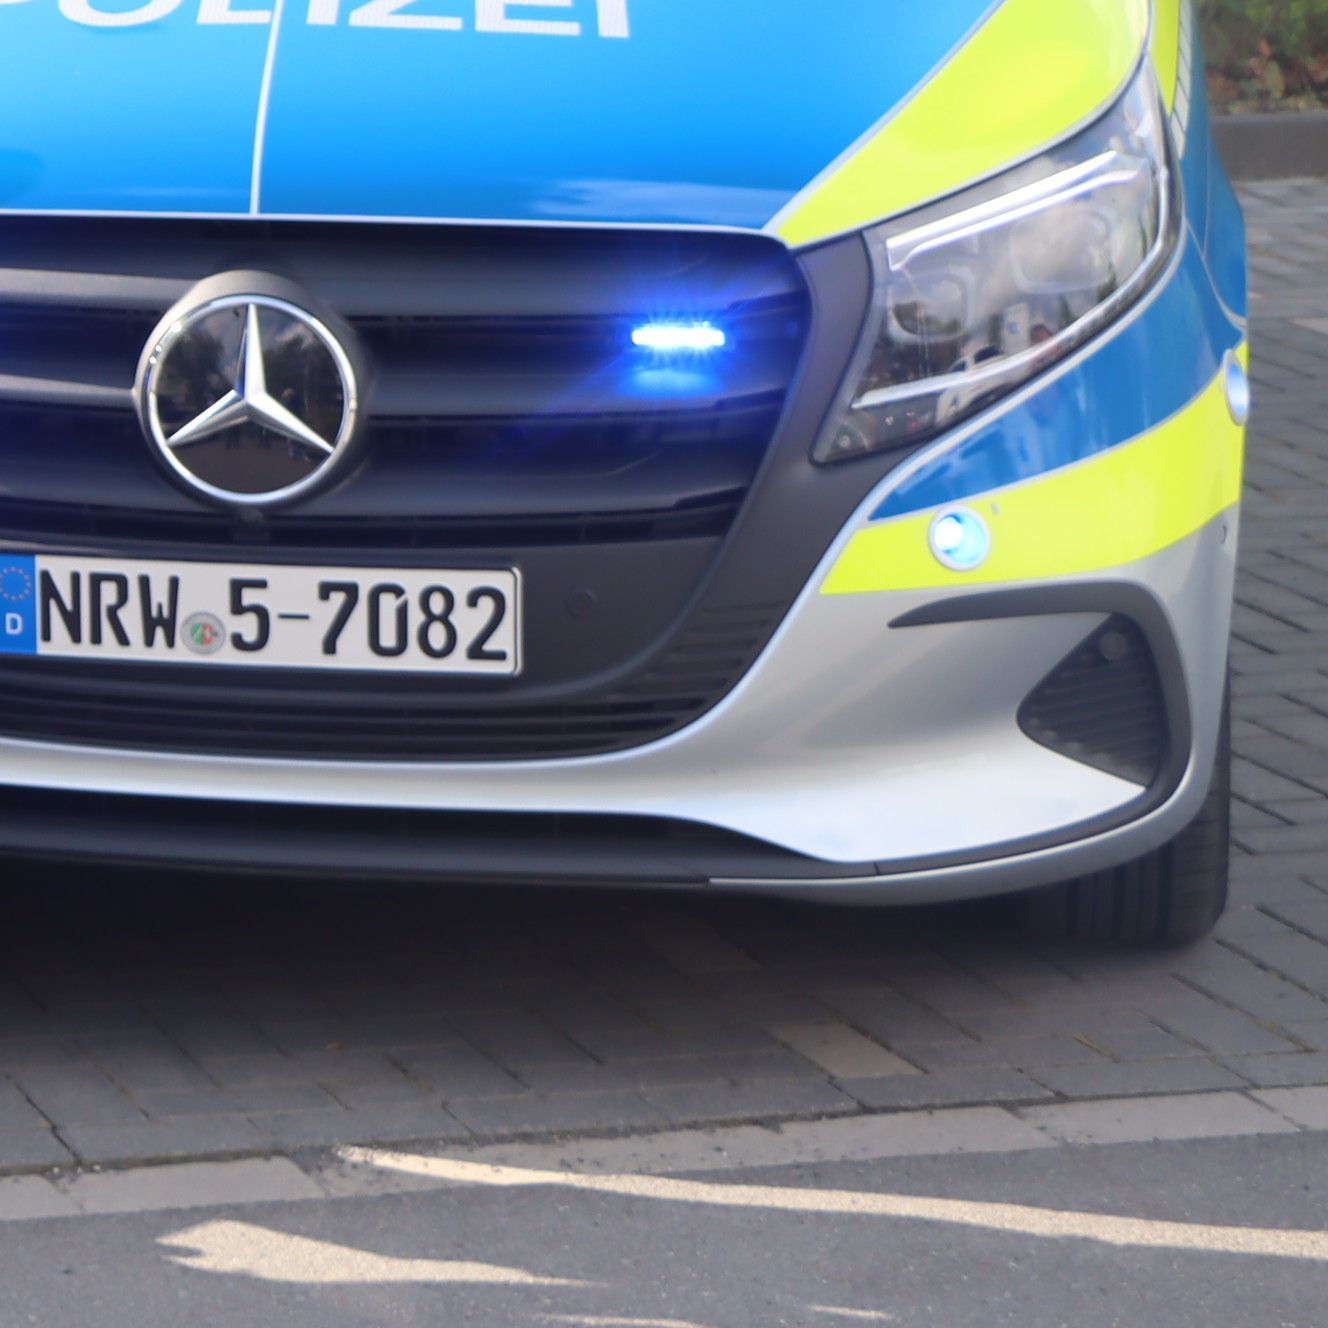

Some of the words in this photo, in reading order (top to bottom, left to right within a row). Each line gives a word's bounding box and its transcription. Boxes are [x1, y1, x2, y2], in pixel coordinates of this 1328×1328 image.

[4, 612, 23, 635] D
[39, 568, 180, 648] NRW
[229, 577, 508, 661] 5-7082
